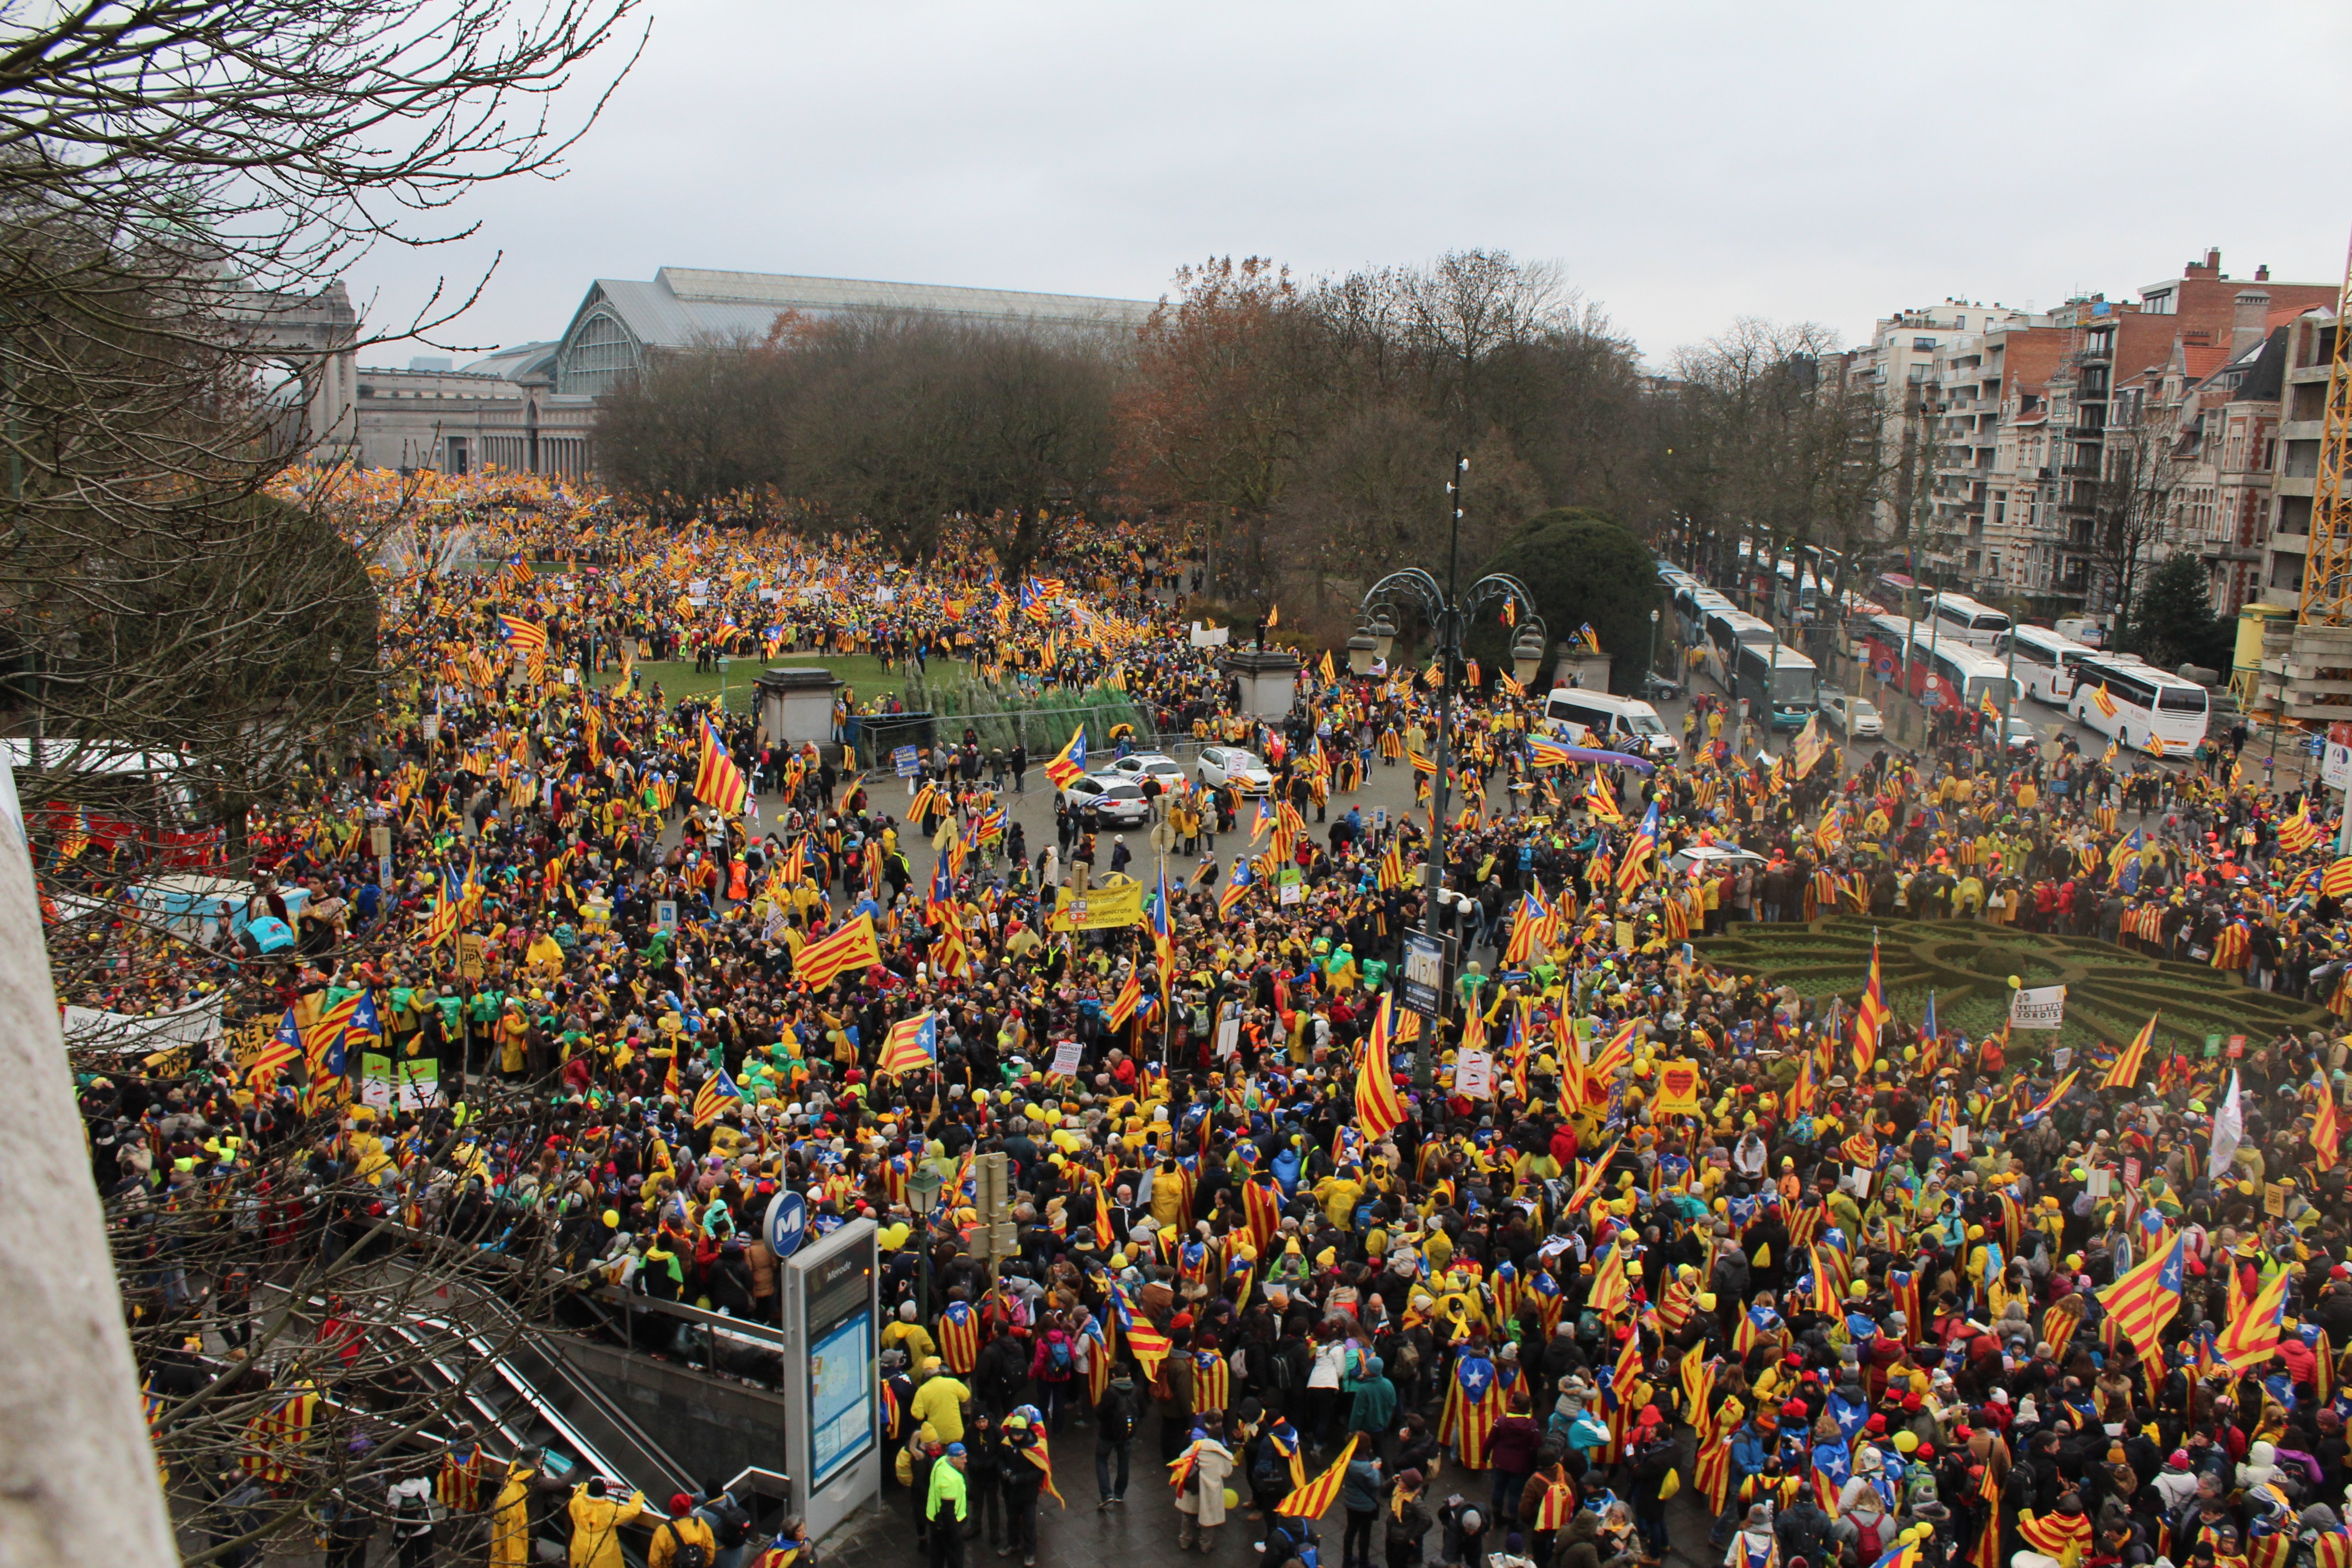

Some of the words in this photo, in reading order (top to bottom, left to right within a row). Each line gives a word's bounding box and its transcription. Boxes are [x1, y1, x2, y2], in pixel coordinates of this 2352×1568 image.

[2313, 735, 2321, 744] P
[990, 914, 996, 926] F
[2016, 1002, 2063, 1012] LLIBERTAT
[777, 1206, 801, 1242] M
[827, 1261, 852, 1282] Merode
